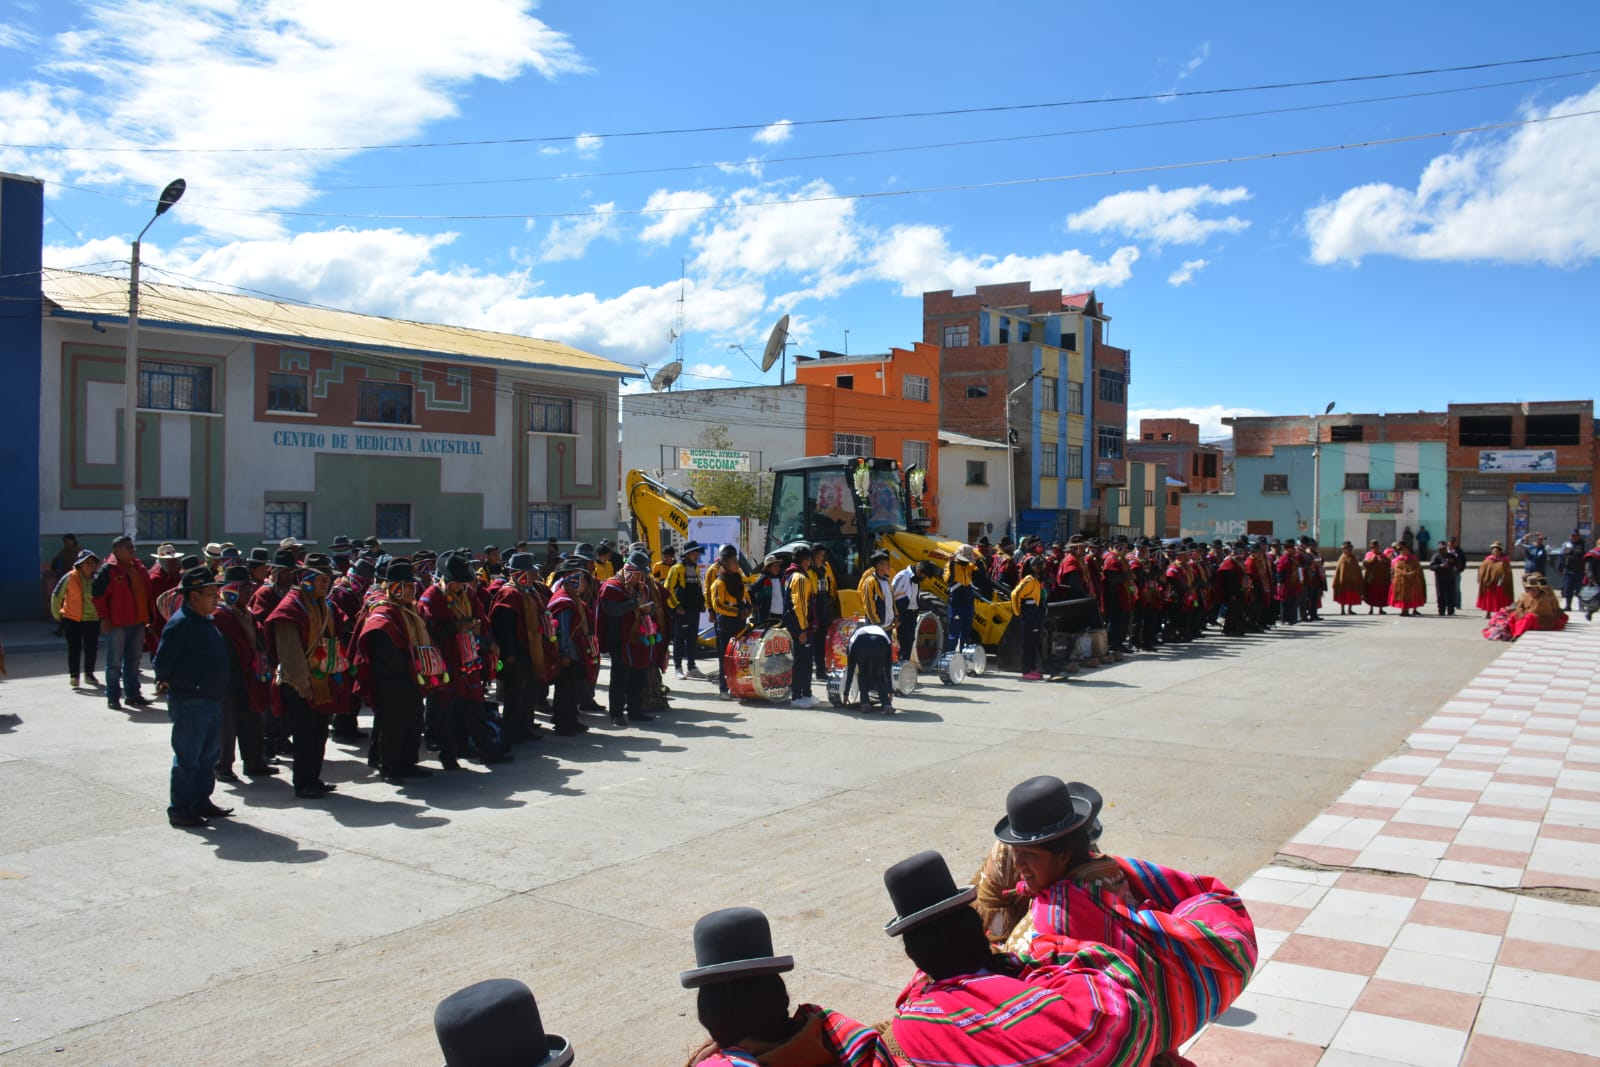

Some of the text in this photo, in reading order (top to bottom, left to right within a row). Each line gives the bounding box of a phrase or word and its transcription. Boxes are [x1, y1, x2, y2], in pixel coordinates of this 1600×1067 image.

[273, 430, 483, 455] CENTRO DE MEDICINA ANCESTRAL
[690, 449, 717, 457] HOSPITAL
[719, 451, 741, 459] AYMARA
[669, 510, 688, 531] NEW
[764, 635, 791, 657] DON
